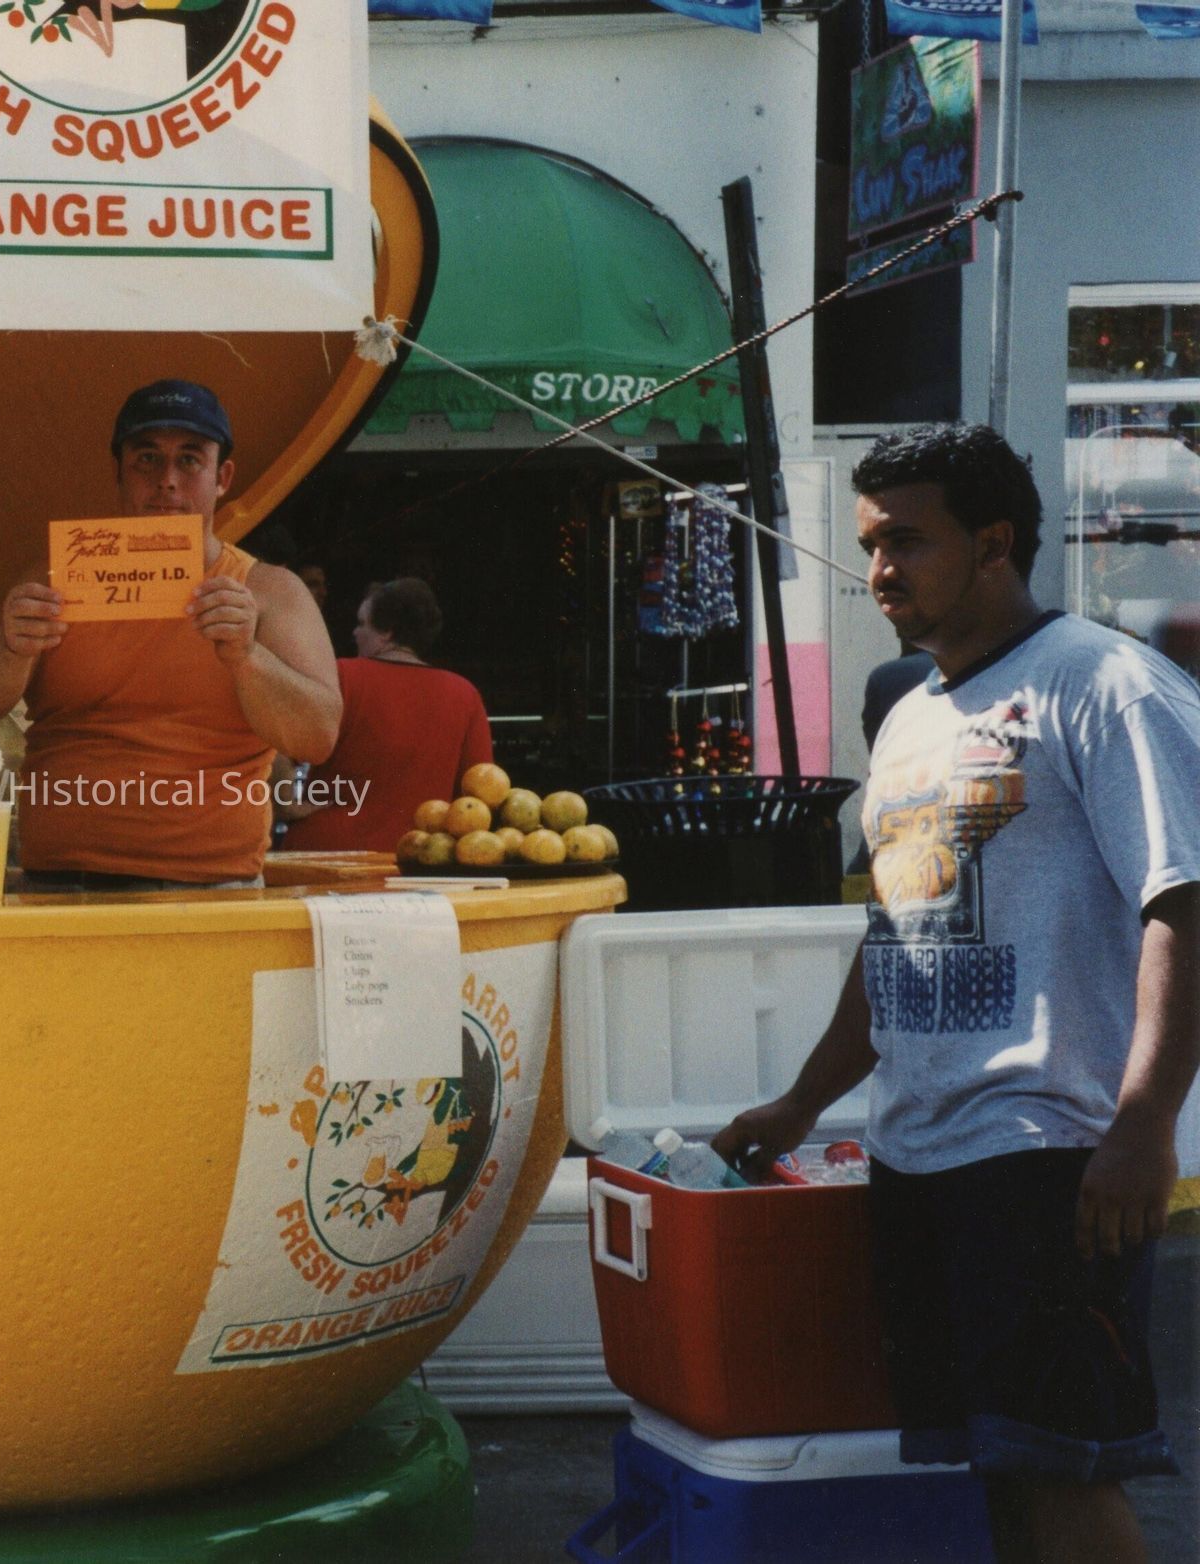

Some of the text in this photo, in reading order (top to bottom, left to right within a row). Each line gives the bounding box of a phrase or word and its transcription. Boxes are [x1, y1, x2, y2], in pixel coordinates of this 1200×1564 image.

[52, 2, 296, 164] SQUEEZED
[148, 197, 312, 241] JUICE
[531, 371, 658, 405] STORE
[95, 568, 157, 583] Vendor
[161, 566, 191, 581] I.D.
[461, 971, 520, 1084] ARROT
[276, 1158, 500, 1300] FRESH SQUEEZED
[225, 1282, 456, 1354] ORANGE JUICE
